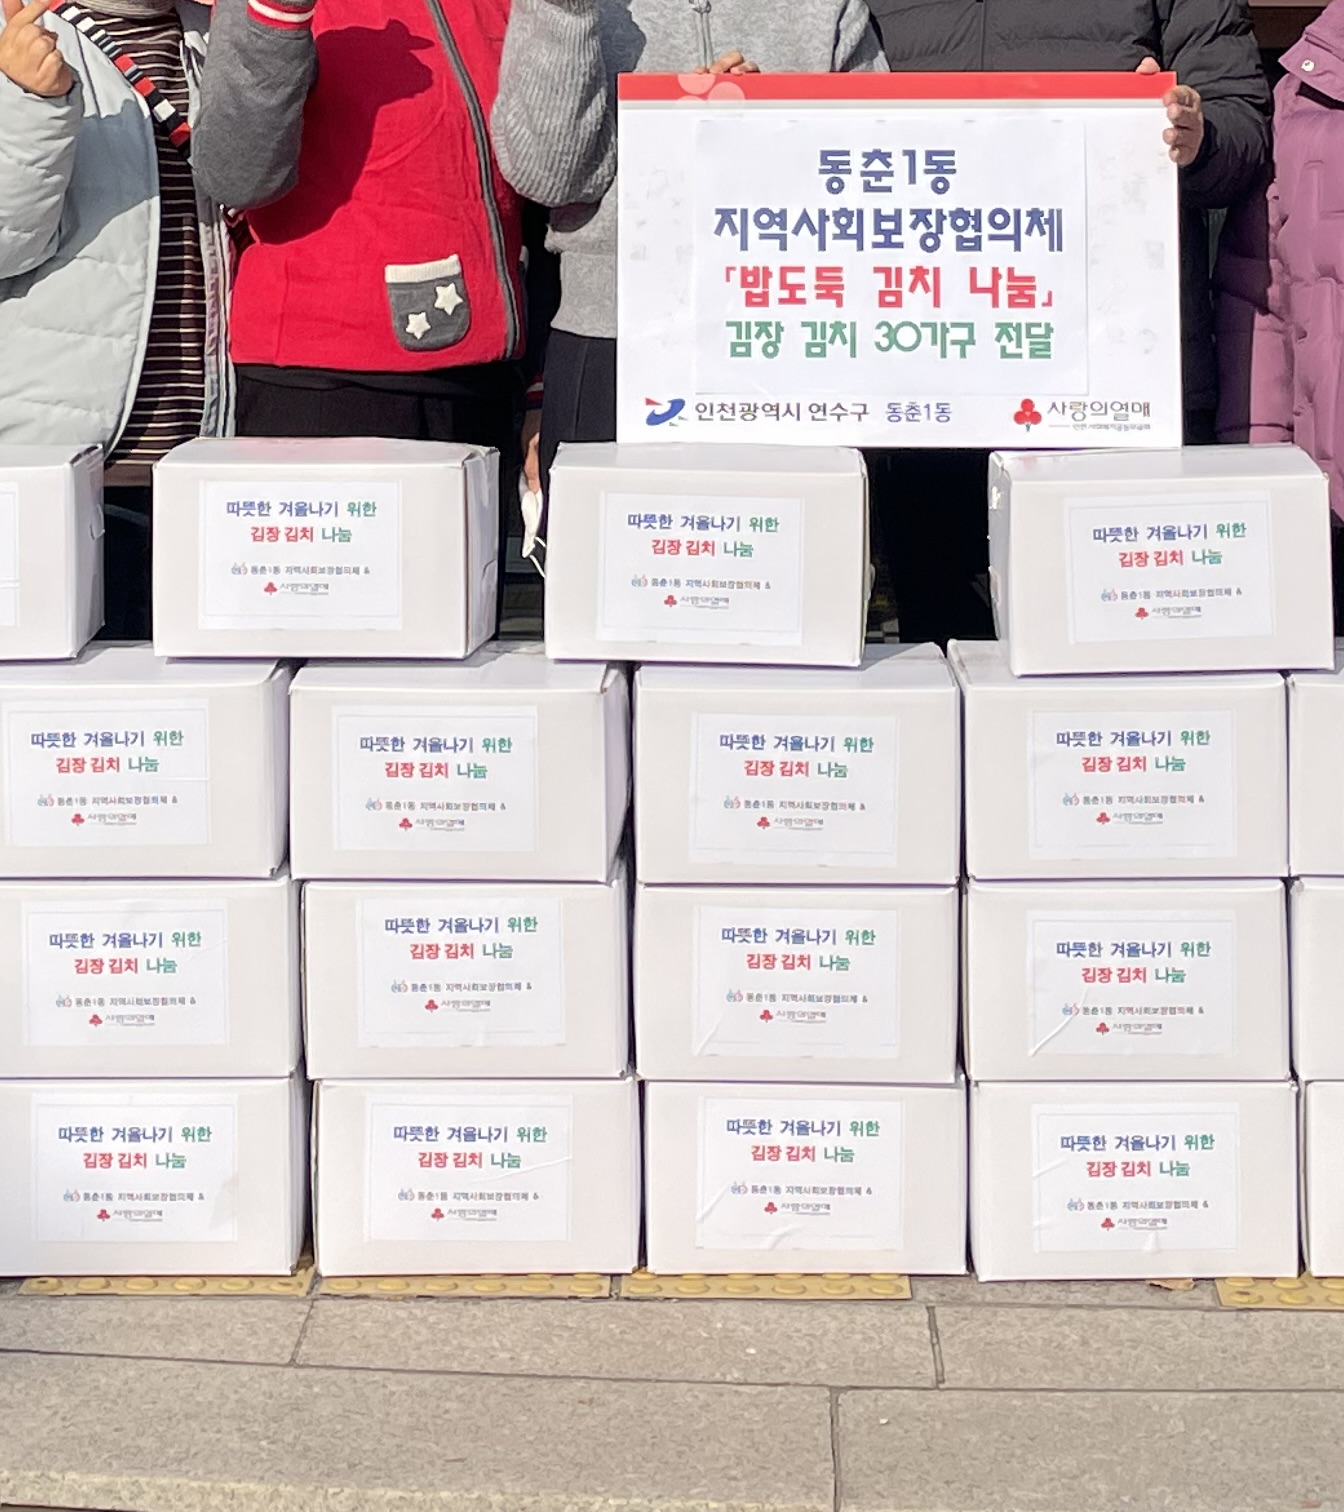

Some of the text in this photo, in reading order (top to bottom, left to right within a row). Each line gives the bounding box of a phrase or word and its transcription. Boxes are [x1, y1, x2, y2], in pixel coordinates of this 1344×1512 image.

[817, 148, 958, 196] 동춘1동
[714, 206, 1064, 254] 지역사회보장협의체
[725, 264, 1054, 309] 「밥도둑 김치 나눔」
[725, 319, 1054, 362] 김장 김치 30가구 전달
[694, 400, 953, 424] 인천광역시 연수구 동춘1동
[1047, 400, 1151, 422] 사랑의열매
[359, 736, 513, 754] 따뜻한 겨울나기 위한
[384, 761, 488, 780] 김장 김치 나눔
